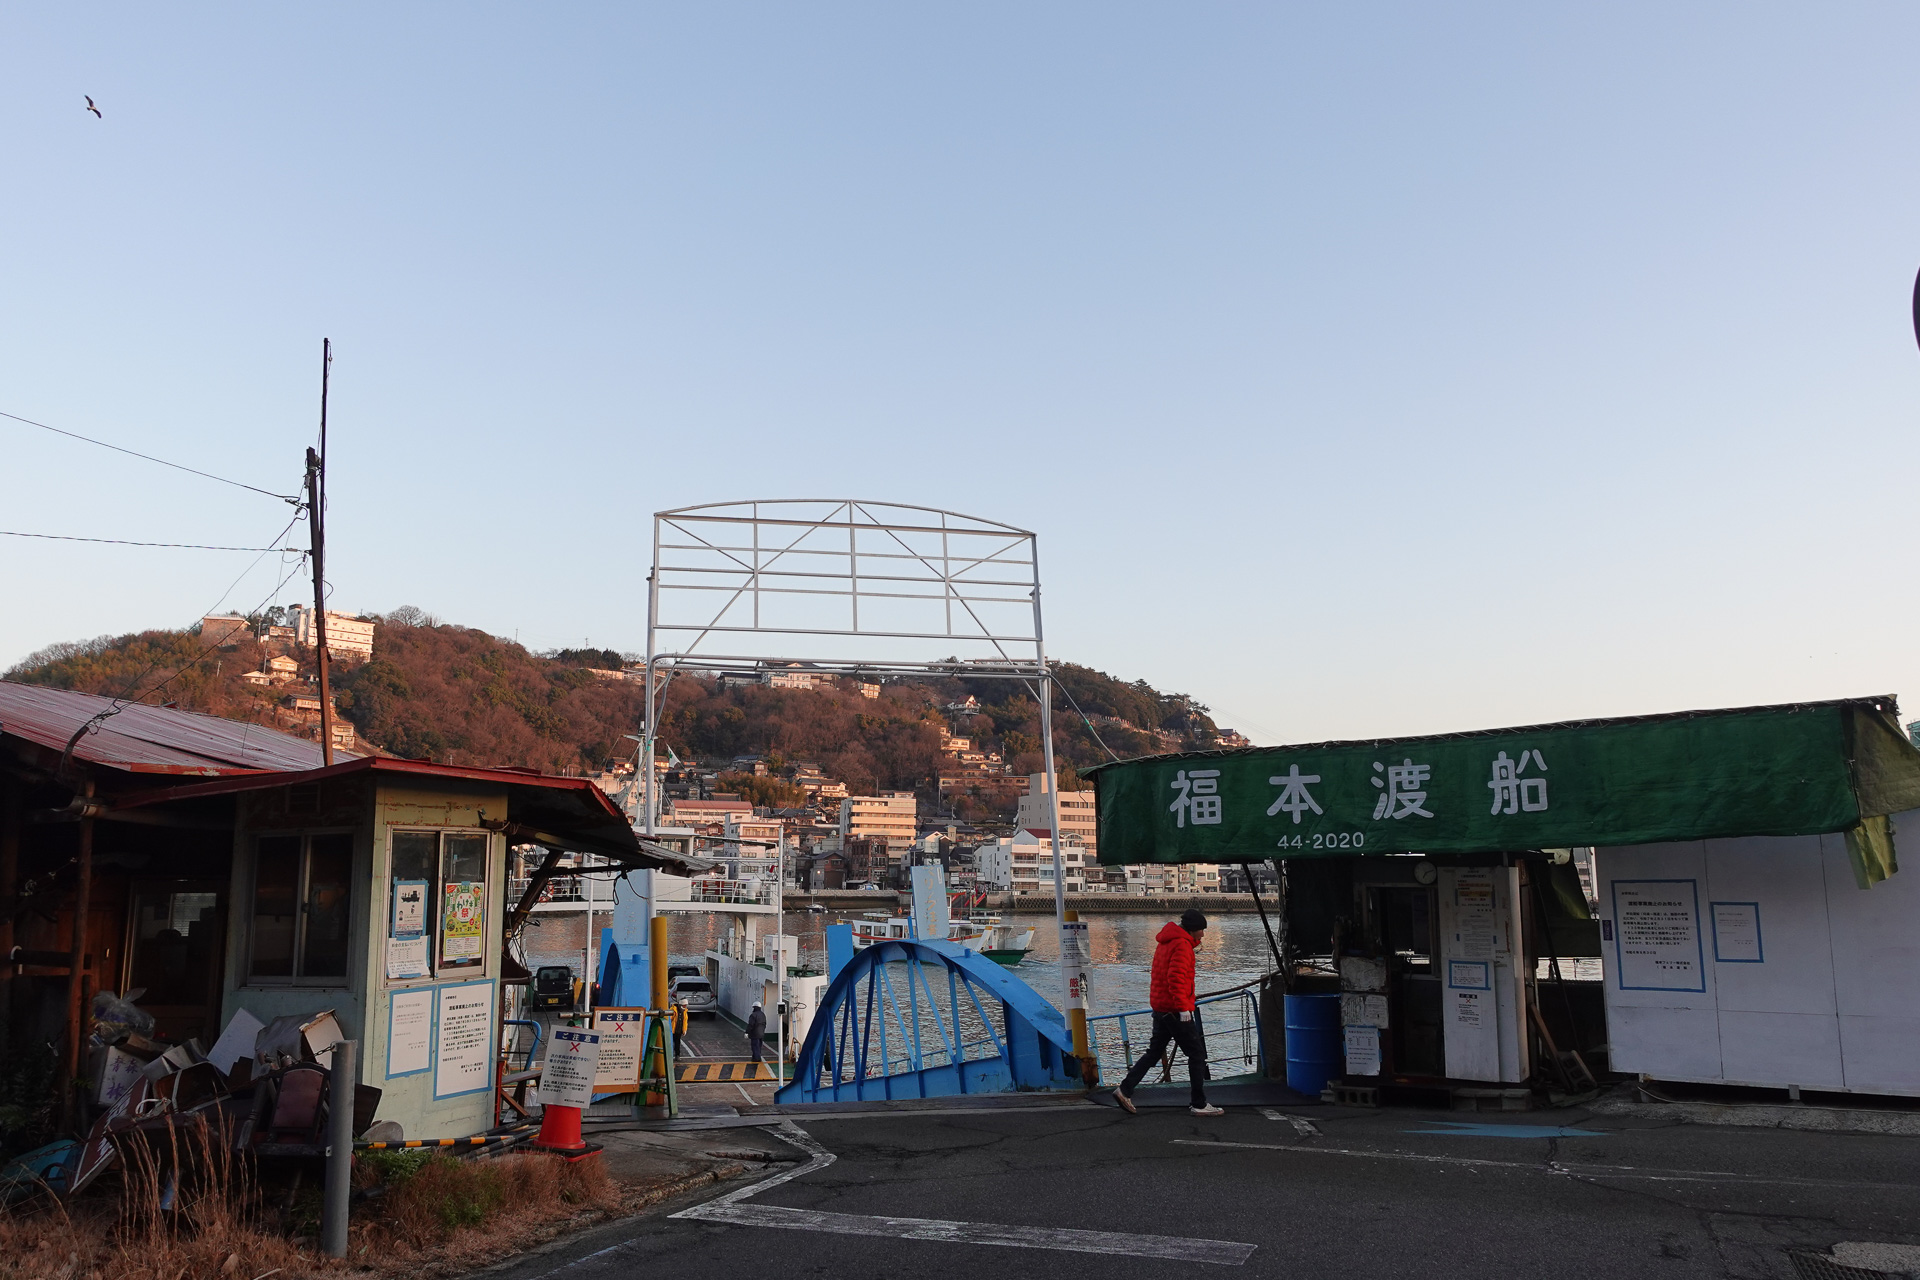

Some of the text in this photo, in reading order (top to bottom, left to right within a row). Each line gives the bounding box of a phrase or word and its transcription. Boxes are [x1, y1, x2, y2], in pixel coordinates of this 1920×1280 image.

[1168, 748, 1549, 829] 福本渡船
[1277, 831, 1365, 850] 44-2020
[606, 1013, 634, 1021] ご注意
[561, 1032, 592, 1043] ご注意
